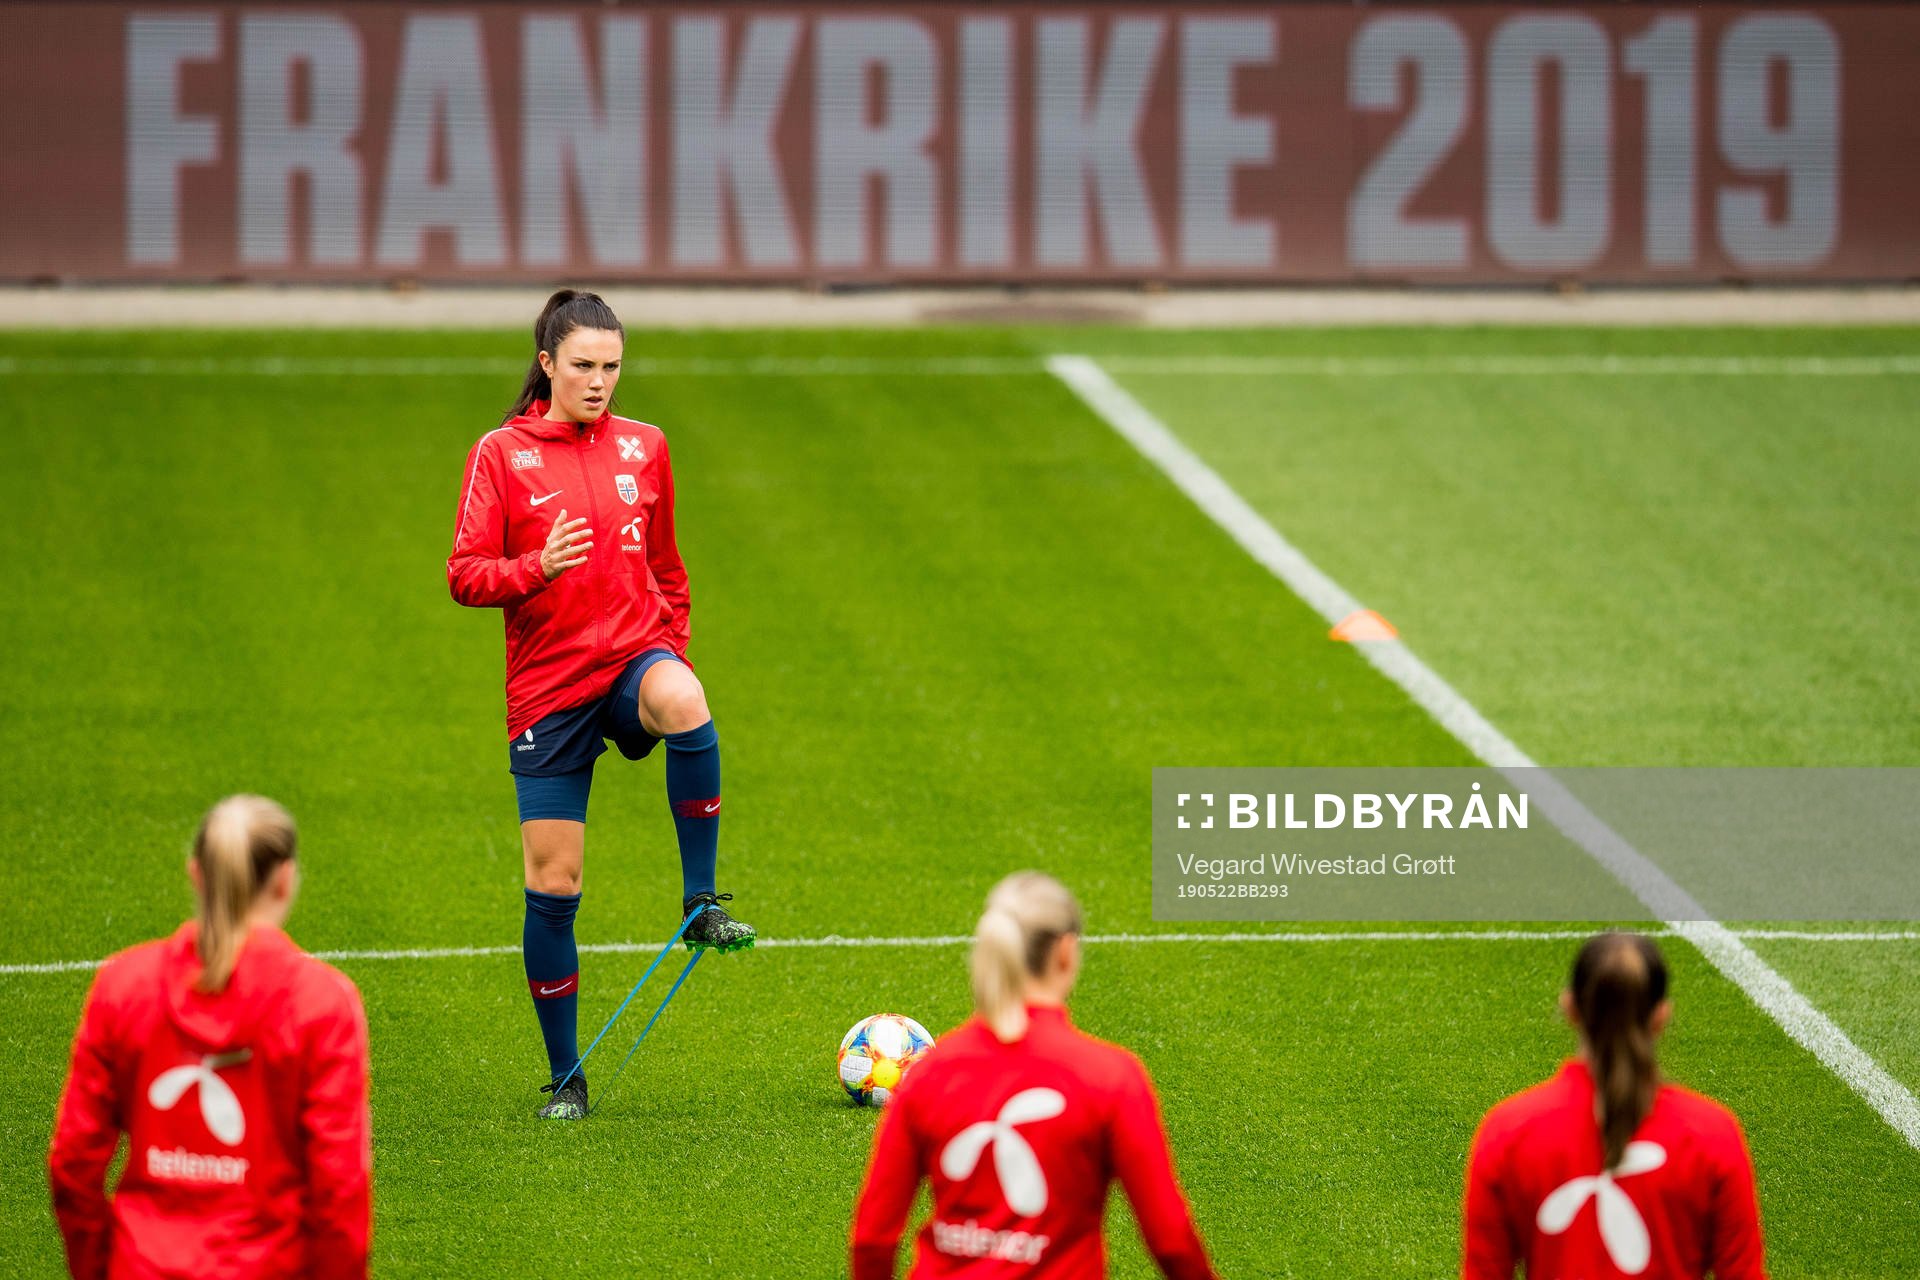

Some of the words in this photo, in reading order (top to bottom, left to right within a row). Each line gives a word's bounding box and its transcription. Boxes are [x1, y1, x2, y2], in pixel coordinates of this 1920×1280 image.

[127, 14, 1276, 267] FRANKRIKE
[1349, 11, 1841, 271] 2019
[514, 456, 538, 467] TINE
